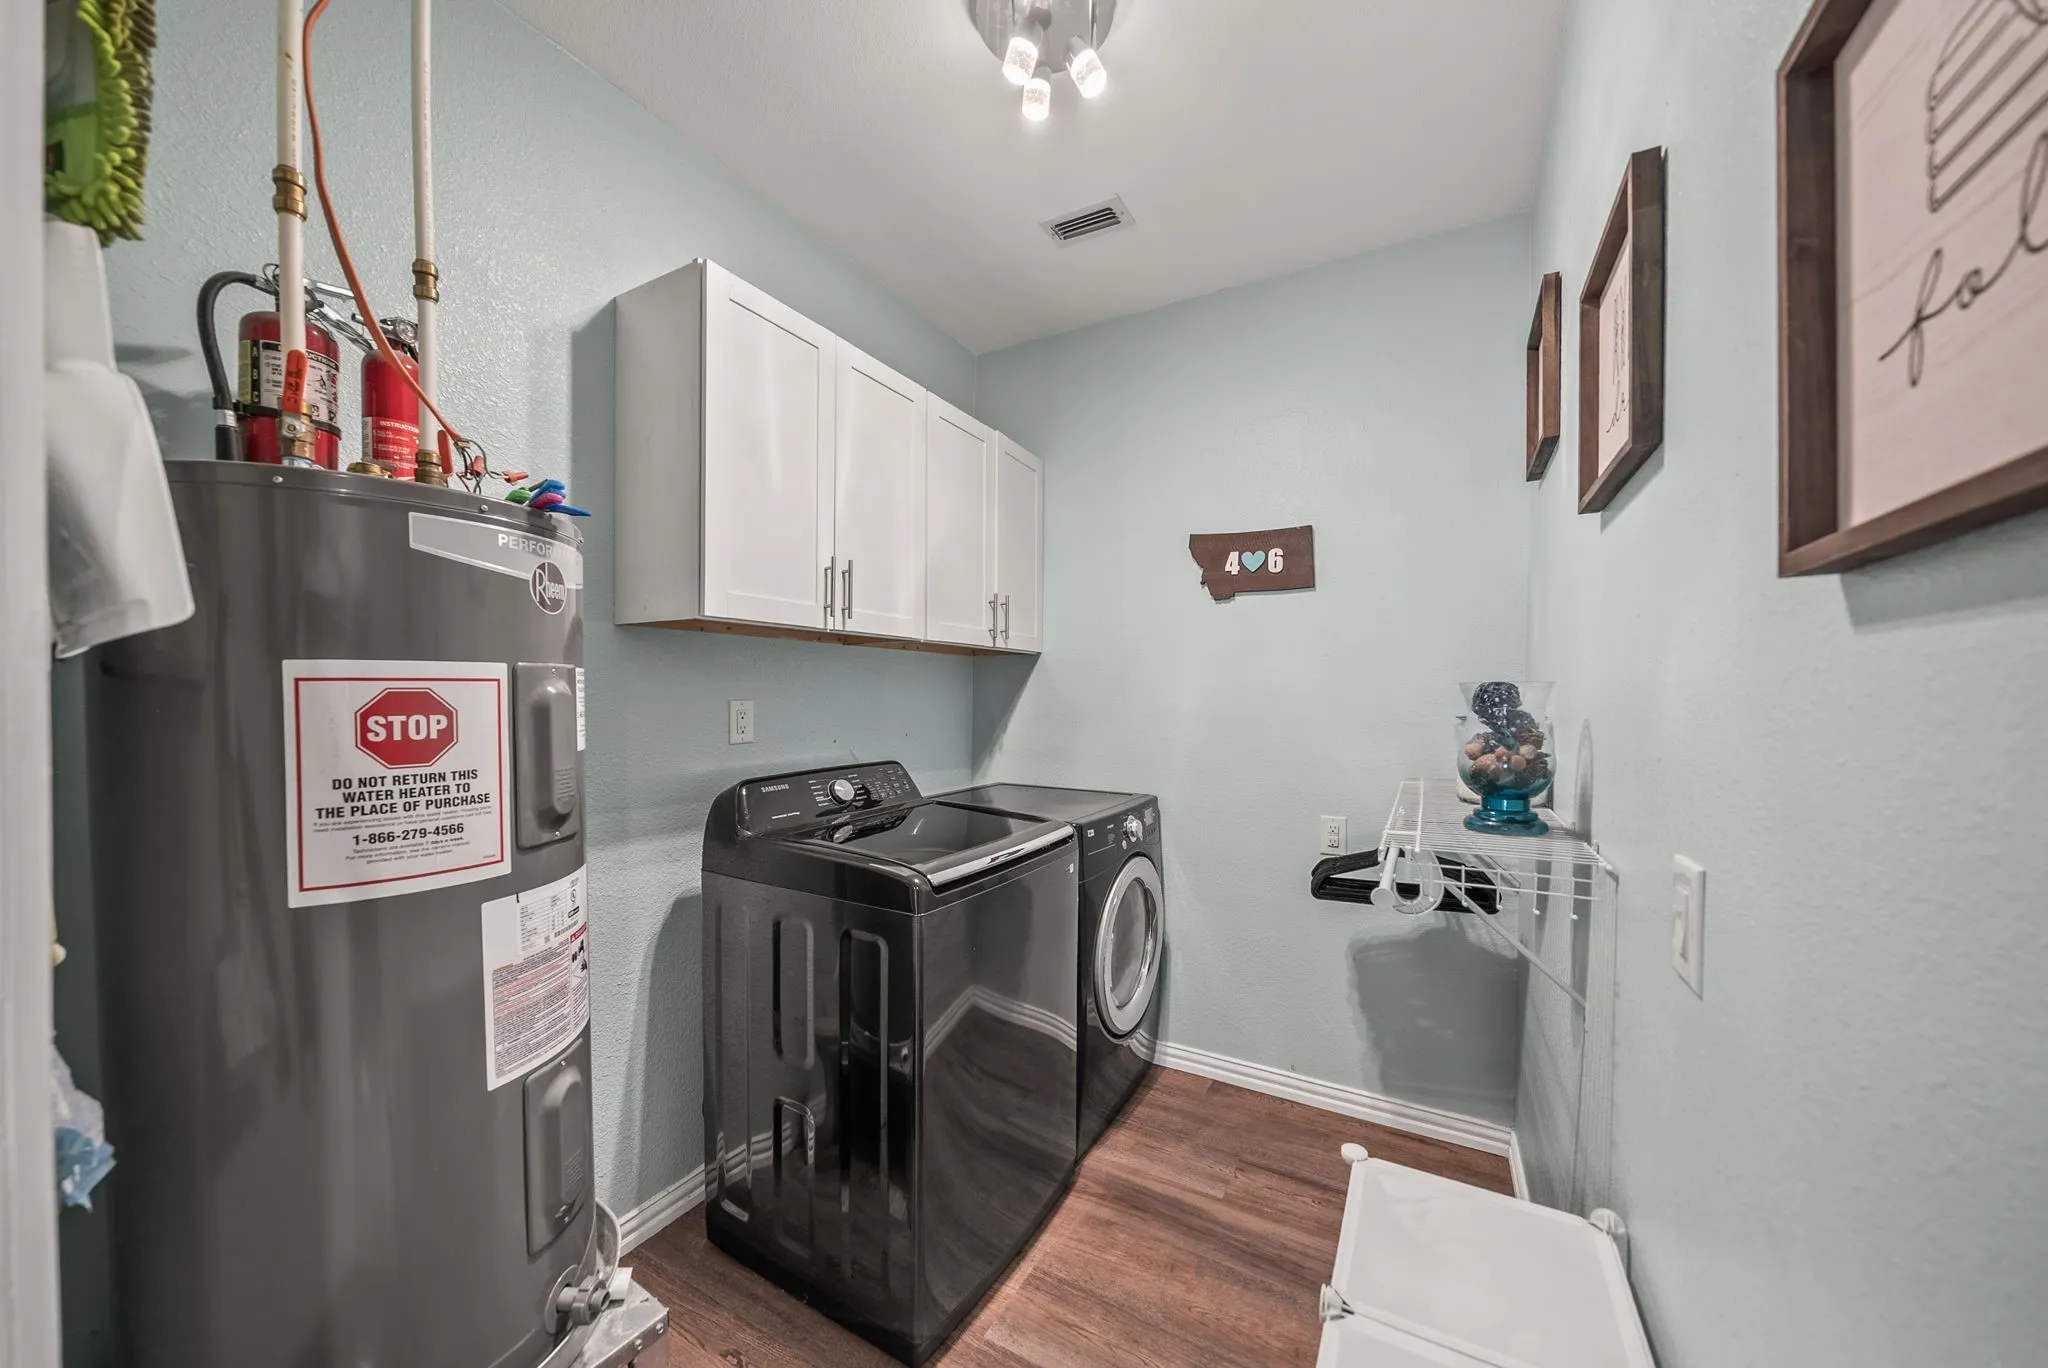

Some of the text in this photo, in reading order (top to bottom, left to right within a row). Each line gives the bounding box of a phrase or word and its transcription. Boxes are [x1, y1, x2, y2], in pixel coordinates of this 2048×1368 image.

[252, 346, 259, 357] A
[252, 368, 259, 380] B
[252, 391, 259, 403] C
[535, 562, 565, 605] Rheem
[366, 714, 448, 743] STOP
[332, 768, 479, 790] DO NOT RETURN THIS
[760, 783, 790, 793] SAMSUNG
[342, 782, 471, 804] WATER HEATER TO
[315, 792, 491, 819] THE PLACE OF PURCHASE
[352, 822, 465, 846] 1-866-279-4566
